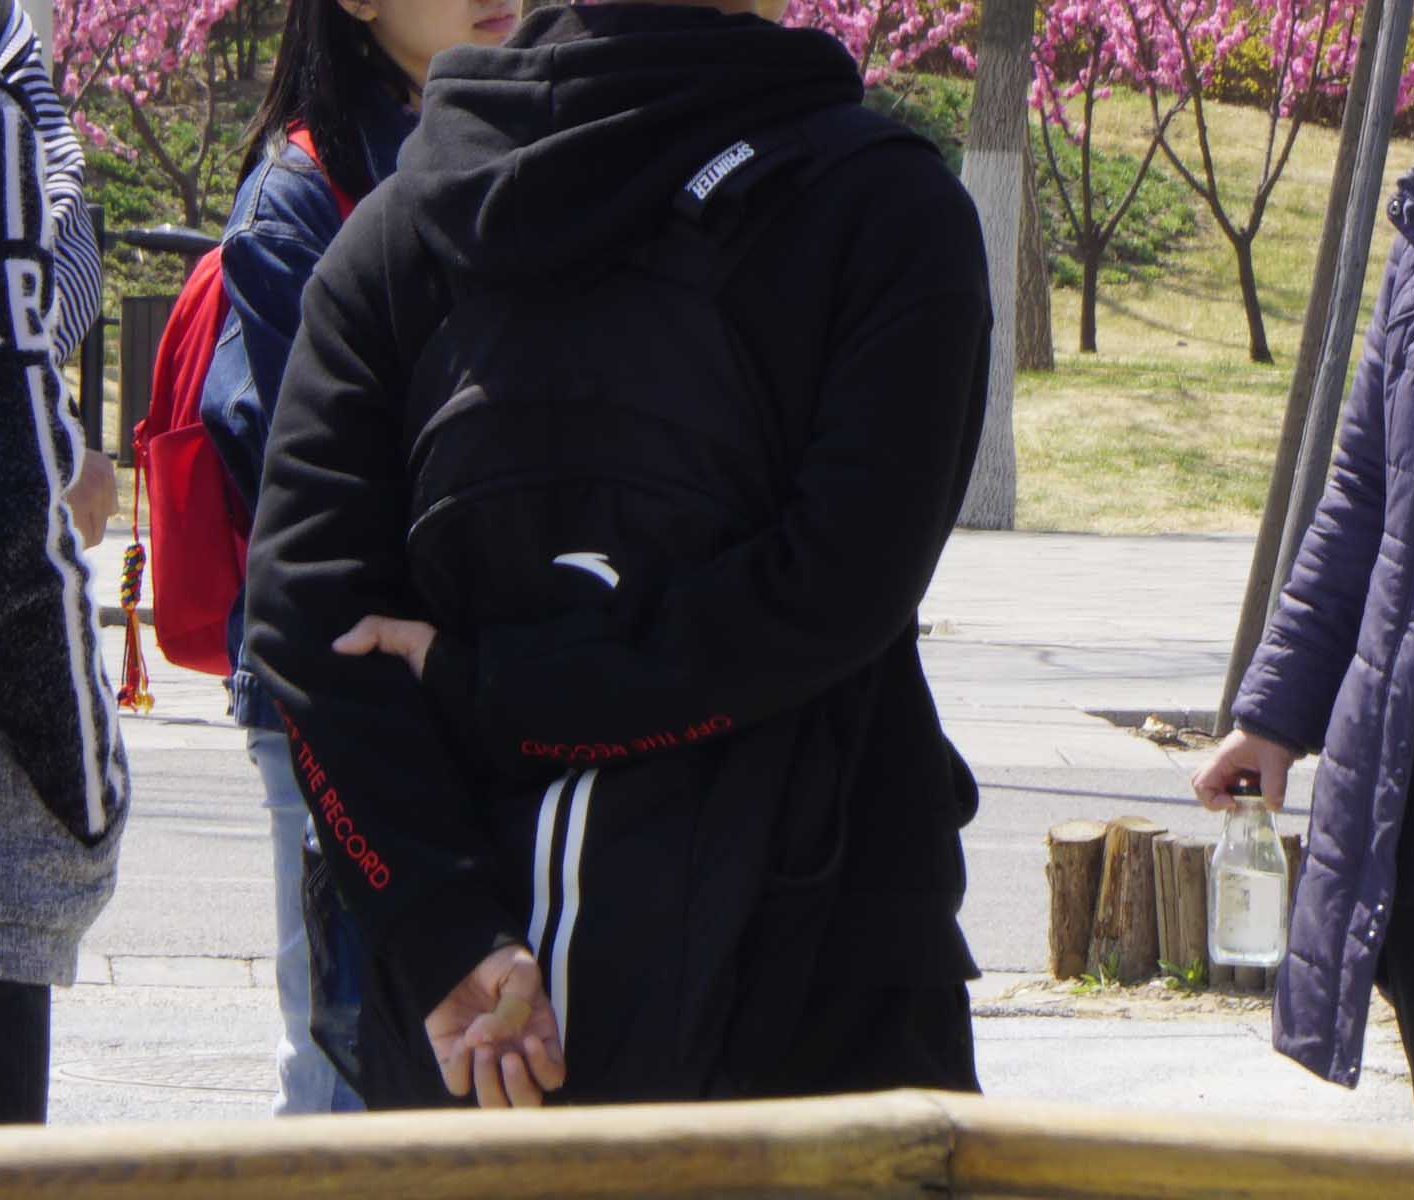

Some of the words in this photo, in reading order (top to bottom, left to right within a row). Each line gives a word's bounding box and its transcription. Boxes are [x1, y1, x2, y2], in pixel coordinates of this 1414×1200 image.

[691, 142, 755, 200] SPRINTER
[298, 743, 328, 793] THE
[319, 787, 391, 891] RECORD
